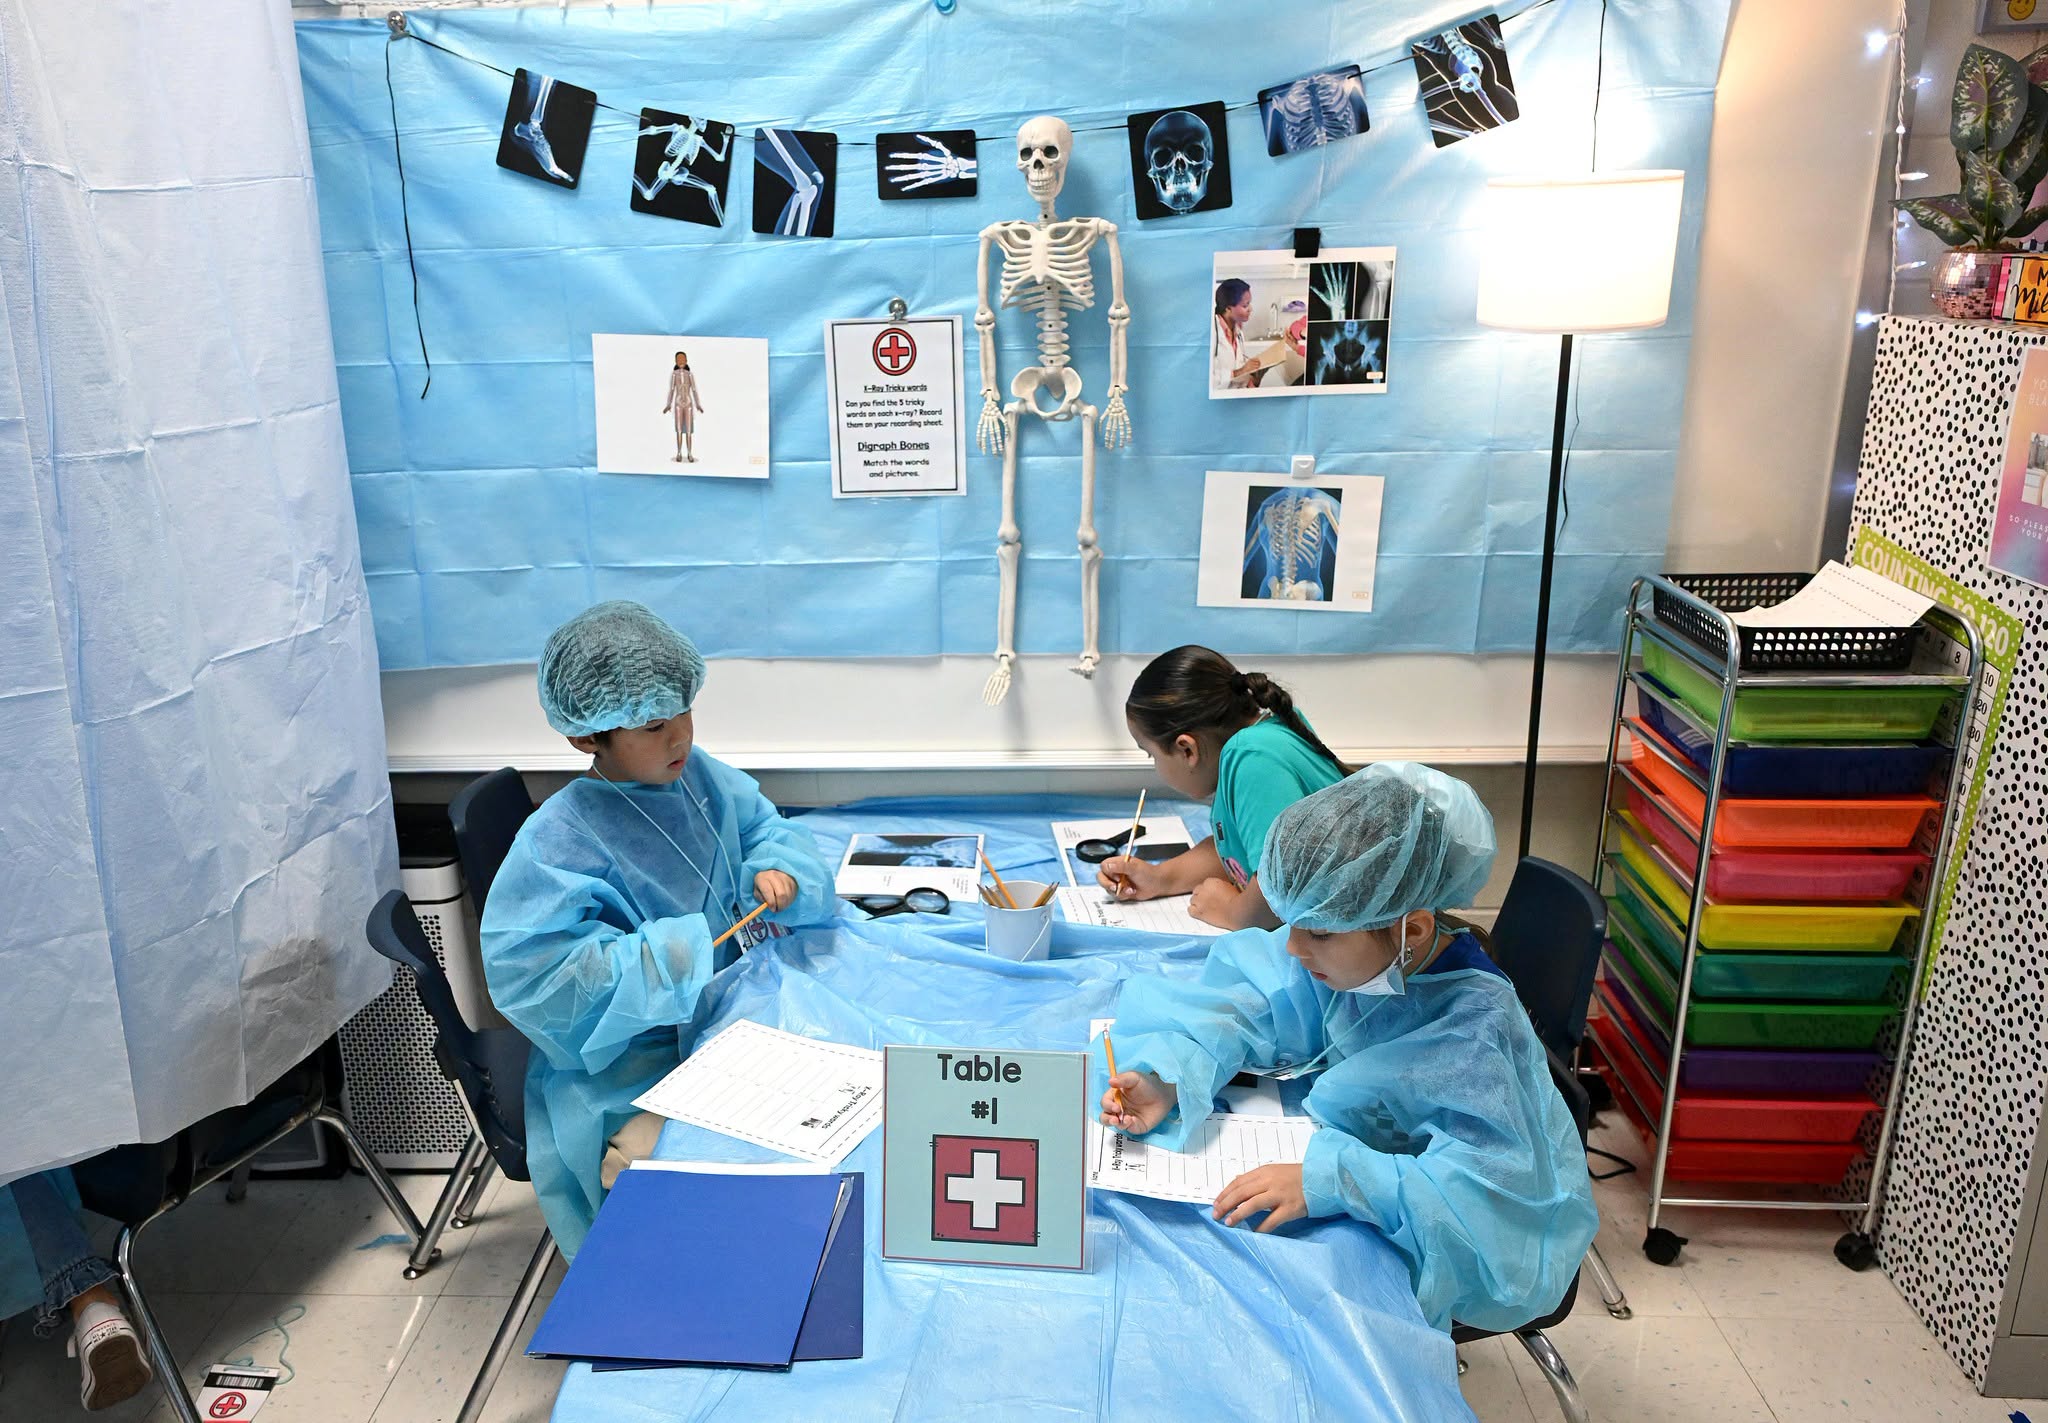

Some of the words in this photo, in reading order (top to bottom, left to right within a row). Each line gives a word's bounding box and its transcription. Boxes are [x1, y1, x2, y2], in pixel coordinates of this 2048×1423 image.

[864, 385, 884, 393] X-Ray
[886, 384, 905, 392] Tricky
[907, 384, 928, 392] words
[905, 398, 925, 407] tricky
[846, 410, 867, 418] words
[895, 409, 918, 417] x-ray?
[919, 408, 943, 416] Record
[874, 421, 889, 429] your
[890, 420, 922, 428] recording
[923, 419, 943, 427] sheet.
[858, 441, 897, 453] Digraph
[900, 440, 930, 451] Bones
[863, 459, 888, 467] Match
[904, 458, 930, 466] words
[885, 469, 920, 479] pictures.
[2009, 514, 2020, 523] SO
[2021, 527, 2042, 541] YOUR
[1979, 613, 2010, 657] 120
[1954, 651, 1961, 664] 8
[1984, 672, 1995, 688] 10
[1976, 698, 1988, 715] 20
[937, 1053, 1022, 1083] Table
[971, 1097, 998, 1125] #1
